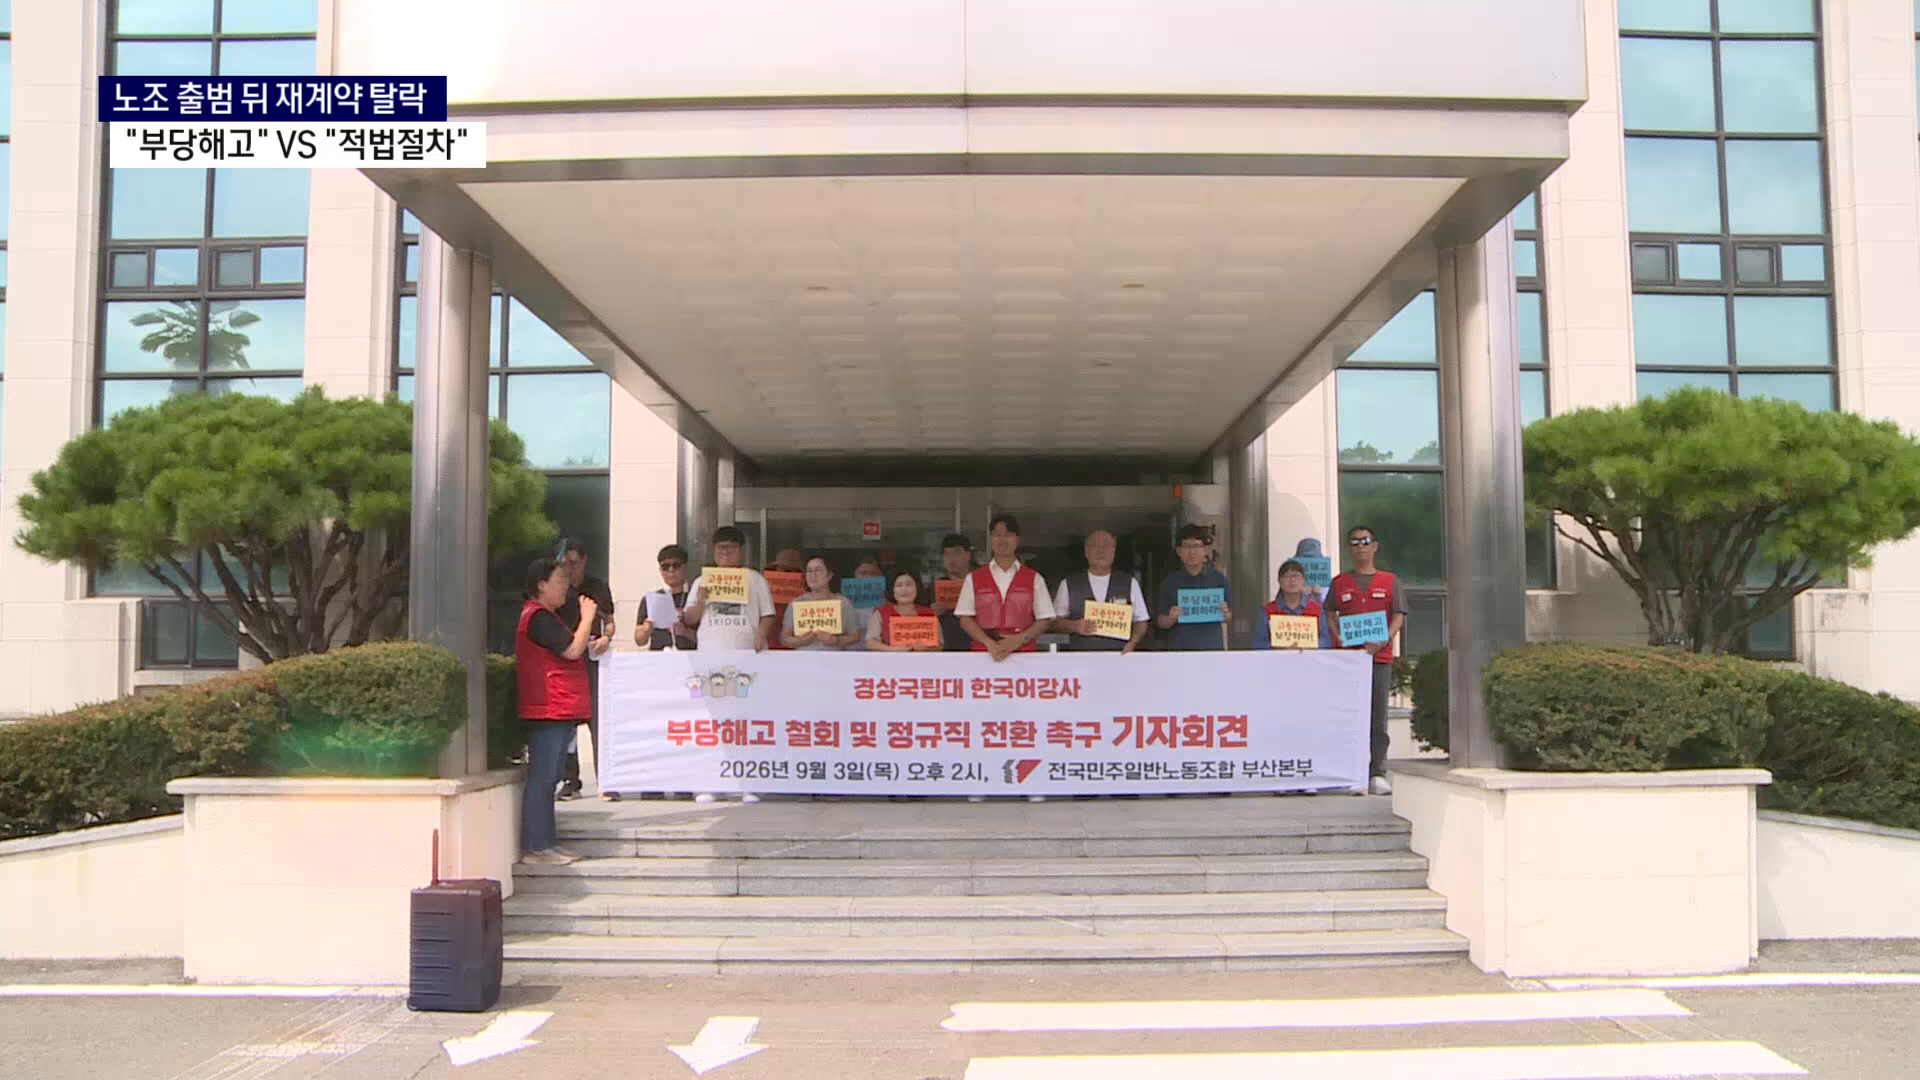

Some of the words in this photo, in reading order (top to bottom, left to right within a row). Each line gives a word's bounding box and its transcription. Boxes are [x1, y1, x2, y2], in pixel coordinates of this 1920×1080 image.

[706, 574, 743, 585] 고용안정
[800, 607, 835, 618] 고용안정
[1090, 607, 1127, 621] 고용안정
[1090, 618, 1128, 632] 장하라!
[1342, 616, 1383, 630] 부당해고
[854, 677, 965, 701] 경상국립대
[970, 677, 1081, 701] 한국어강사
[666, 719, 777, 747] 부당해고
[785, 719, 841, 749] 철회
[850, 720, 878, 749] 및
[887, 720, 971, 749] 정규직
[981, 719, 1038, 749] 전환
[1046, 720, 1102, 749] 촉구
[1112, 713, 1249, 750] 기자회견
[720, 760, 789, 781] 2026년
[796, 761, 827, 781] 9월
[833, 761, 900, 783] 3일(목)
[907, 762, 945, 782] 오후
[951, 762, 990, 783] 2시,
[1048, 758, 1236, 782] 전국민주일반노동조합
[1241, 758, 1313, 779] 부산본부
